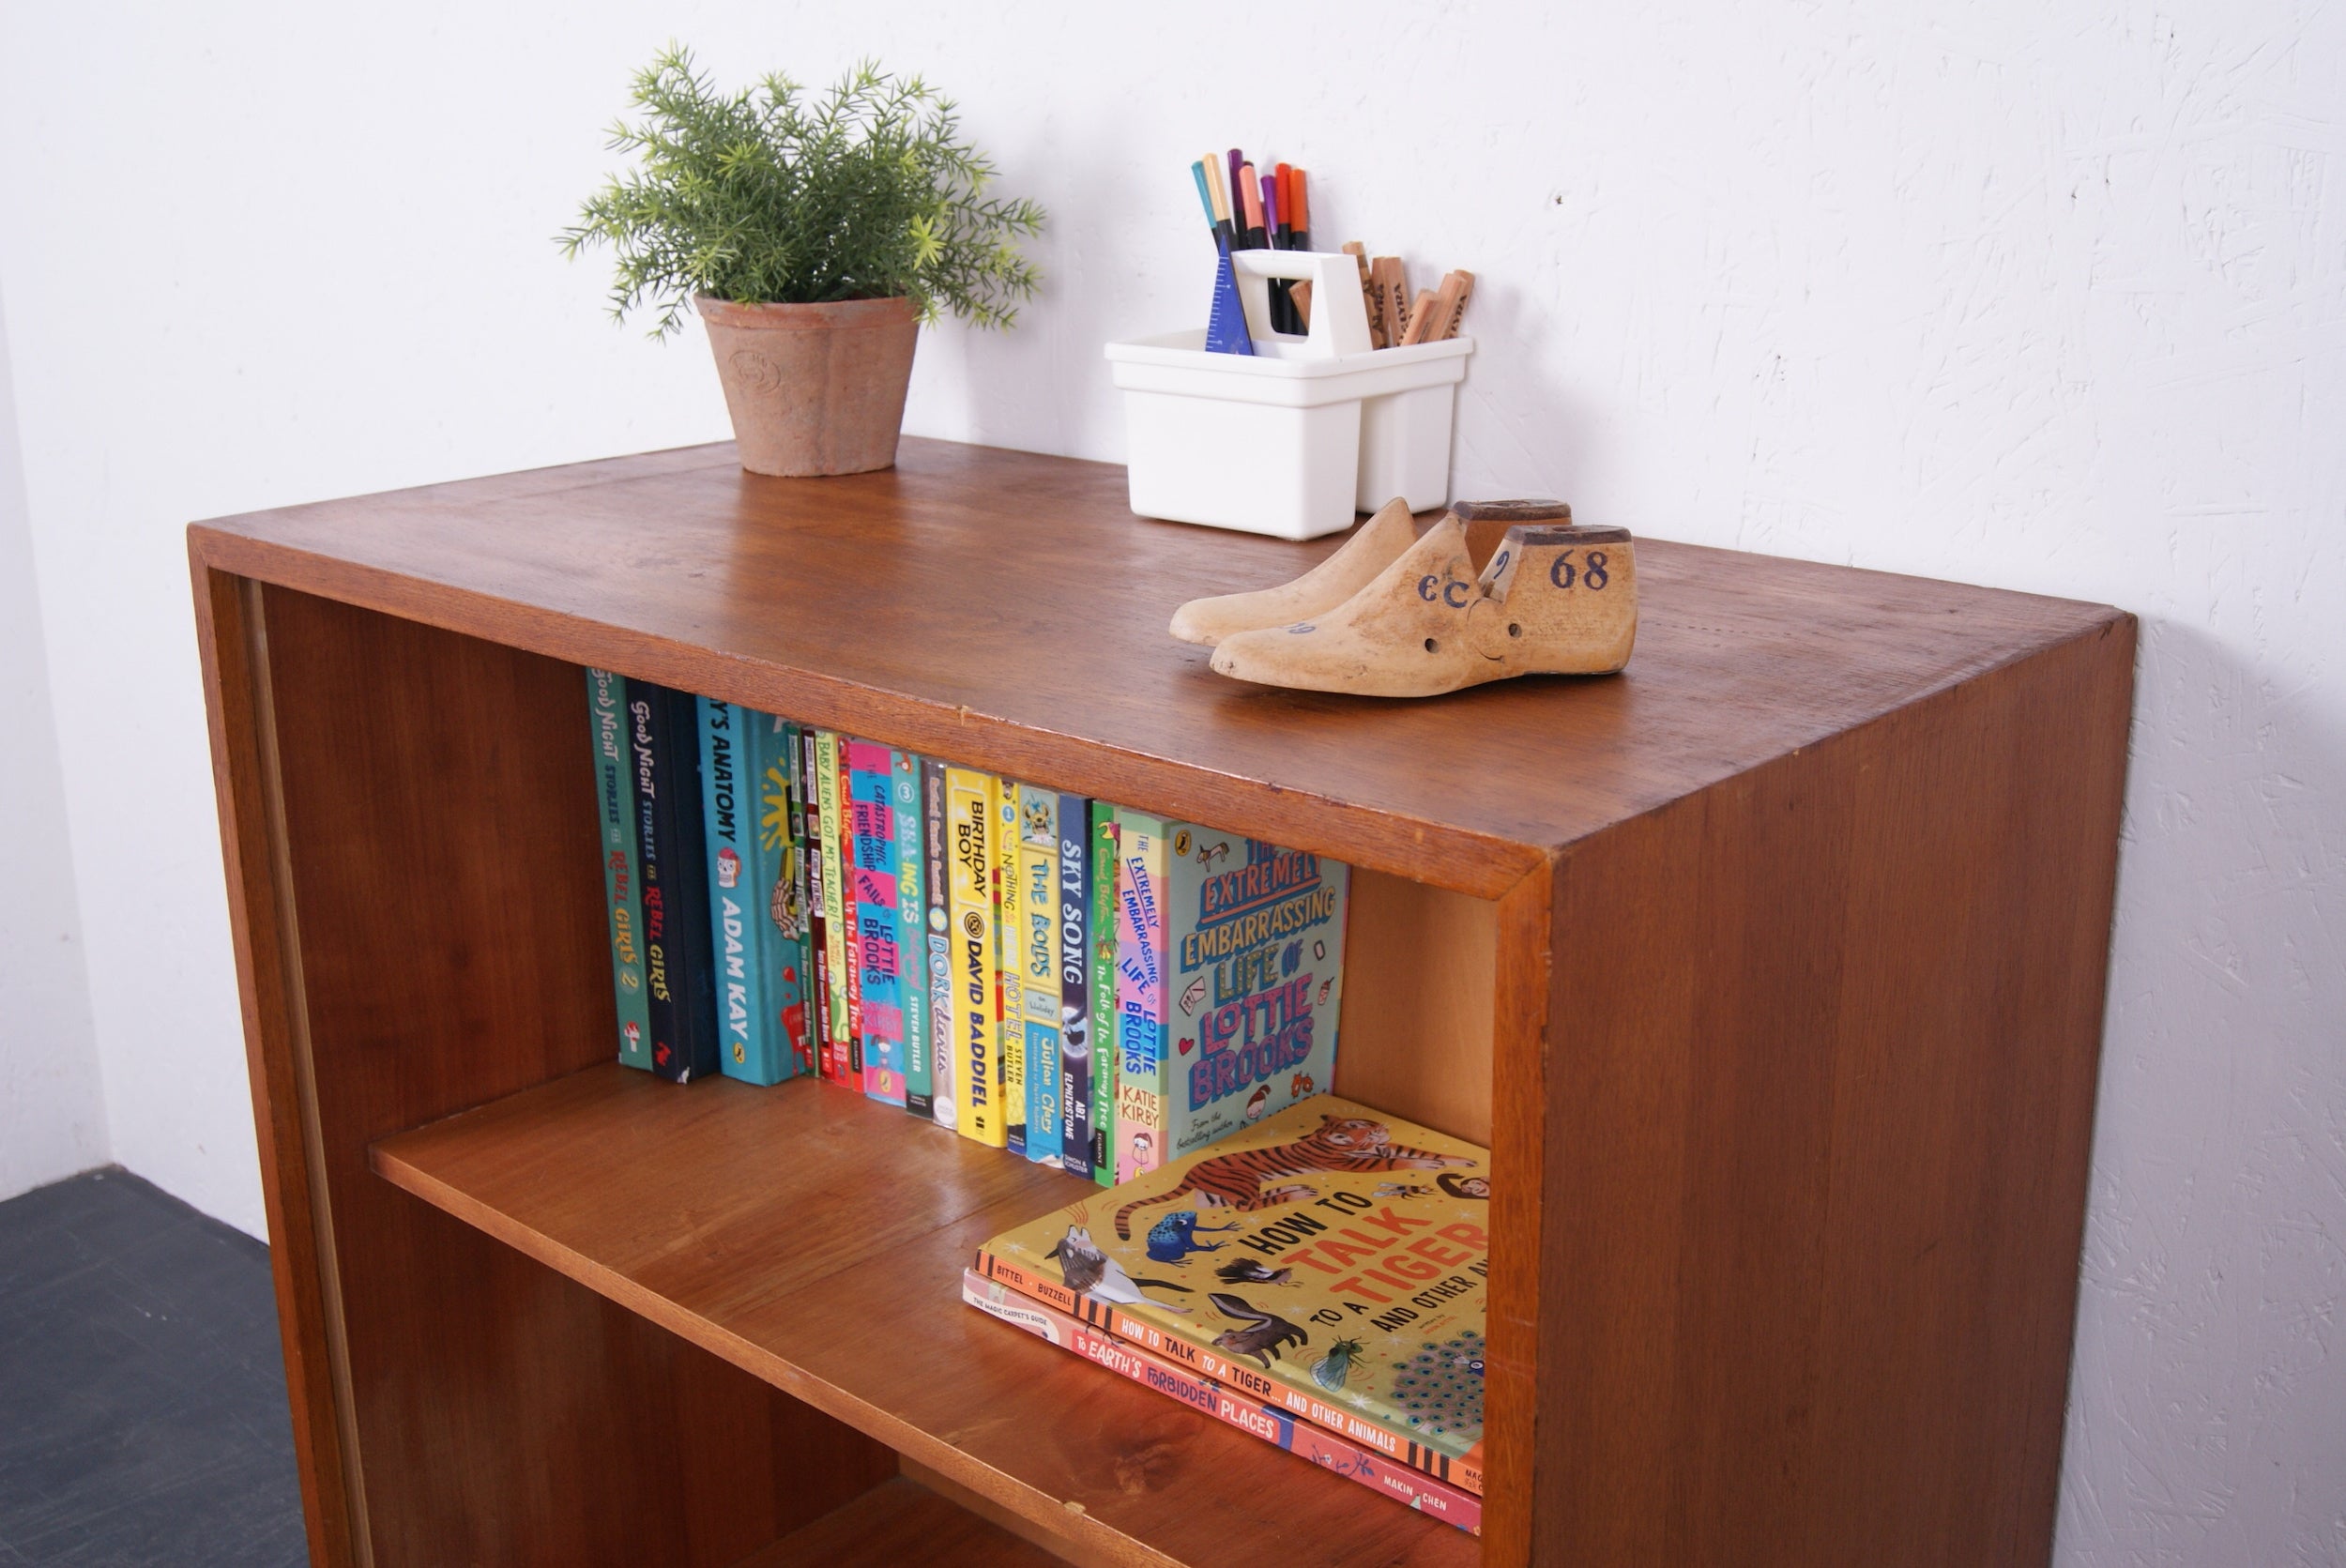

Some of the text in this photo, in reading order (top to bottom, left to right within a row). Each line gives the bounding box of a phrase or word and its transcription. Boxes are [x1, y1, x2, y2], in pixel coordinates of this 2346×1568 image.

[1550, 548, 1609, 592] 68
[817, 740, 831, 771] BABY
[604, 765, 620, 825] STORIES
[711, 735, 737, 844] ANATOMY
[819, 772, 833, 812] ALIENS
[1005, 808, 1012, 819] 1
[642, 800, 657, 861] STORIES
[822, 814, 835, 842] GOT
[824, 845, 835, 862] MY
[855, 804, 876, 872] FRIENDSHIP
[874, 784, 888, 866] CATASTROPHIC
[958, 823, 972, 869] BOY
[971, 800, 987, 899] BIRTHDAY
[1137, 835, 1149, 853] THE
[608, 849, 631, 906] REBEL
[897, 812, 919, 898] SEA-ING
[1002, 852, 1018, 912] NOTHING
[1203, 851, 1322, 913] EXTREMELY
[644, 886, 664, 942] REBEL
[812, 880, 824, 912] VIKINGS
[825, 865, 840, 919] TEACHER!
[858, 874, 886, 907] FAILS
[903, 897, 920, 924] IS
[1062, 839, 1083, 985] SKY SONG
[1098, 847, 1110, 925] Enid Blyton
[1131, 857, 1160, 929] EXTREMELY
[1030, 858, 1052, 979] THE BOLDS
[1121, 890, 1159, 984] EMBARRASSING
[1183, 886, 1336, 968] EMBARRASSING
[620, 971, 639, 990] 2
[722, 896, 748, 1042] ADAM KAY
[846, 941, 859, 1000] Faraway
[863, 918, 881, 986] BROOKS
[878, 924, 895, 985] LOTTIE
[1096, 965, 1107, 982] The
[1121, 957, 1150, 995] LIFE
[1217, 938, 1303, 1001] LIFE OF
[849, 1003, 861, 1031] Tree
[929, 935, 952, 1074] DORK diaries
[967, 939, 988, 1108] DAVID BADDIEL
[1003, 970, 1023, 1041] HOTEL
[1095, 1012, 1110, 1028] of
[1099, 982, 1111, 1011] Folk
[1147, 992, 1156, 1006] OF
[1202, 972, 1314, 1057] LOTTIE
[909, 995, 922, 1073] STEVEN BUTLER
[1041, 1037, 1055, 1087] Julian
[1125, 1000, 1143, 1075] BROOKS
[1142, 1009, 1157, 1077] LOTTIE
[1192, 1016, 1315, 1106] BROOKS
[1005, 1045, 1014, 1083] BUTLER
[1014, 1046, 1023, 1086] STEVEN
[1096, 1046, 1109, 1100] Faraway
[1041, 1093, 1057, 1135] Clary
[1064, 1072, 1074, 1141] ELPHINSTONE
[1074, 1100, 1087, 1121] ABI
[1099, 1101, 1111, 1129] Tree
[1121, 1103, 1160, 1127] KIRBY
[1122, 1085, 1158, 1112] KATIE
[1191, 1110, 1222, 1132] From the
[1176, 1132, 1211, 1150] bestselling
[1237, 1191, 1373, 1256] HOW TO
[1280, 1207, 1435, 1275] TALK
[997, 1264, 1072, 1306] BITTEL BUZZELL
[1329, 1223, 1489, 1304] TIGER
[973, 1297, 1048, 1326] THE MAGIC CARPET'S GUIDE
[1309, 1301, 1370, 1328] TO A
[1369, 1306, 1420, 1333] AND
[1411, 1274, 1479, 1310] OTHER
[1076, 1334, 1087, 1351] To
[1087, 1340, 1143, 1379] EARTH'S
[1220, 1399, 1275, 1440] PLACES
[1120, 1317, 1144, 1340] HOW
[1148, 1329, 1160, 1347] TO
[1164, 1336, 1196, 1363] TALK
[1201, 1355, 1216, 1372] TO
[1217, 1363, 1227, 1378] A
[1286, 1391, 1308, 1413] AND
[1311, 1403, 1344, 1430] OTHER
[1348, 1417, 1396, 1453] ANIMALS
[1383, 1474, 1448, 1513] MAKIN CHEN
